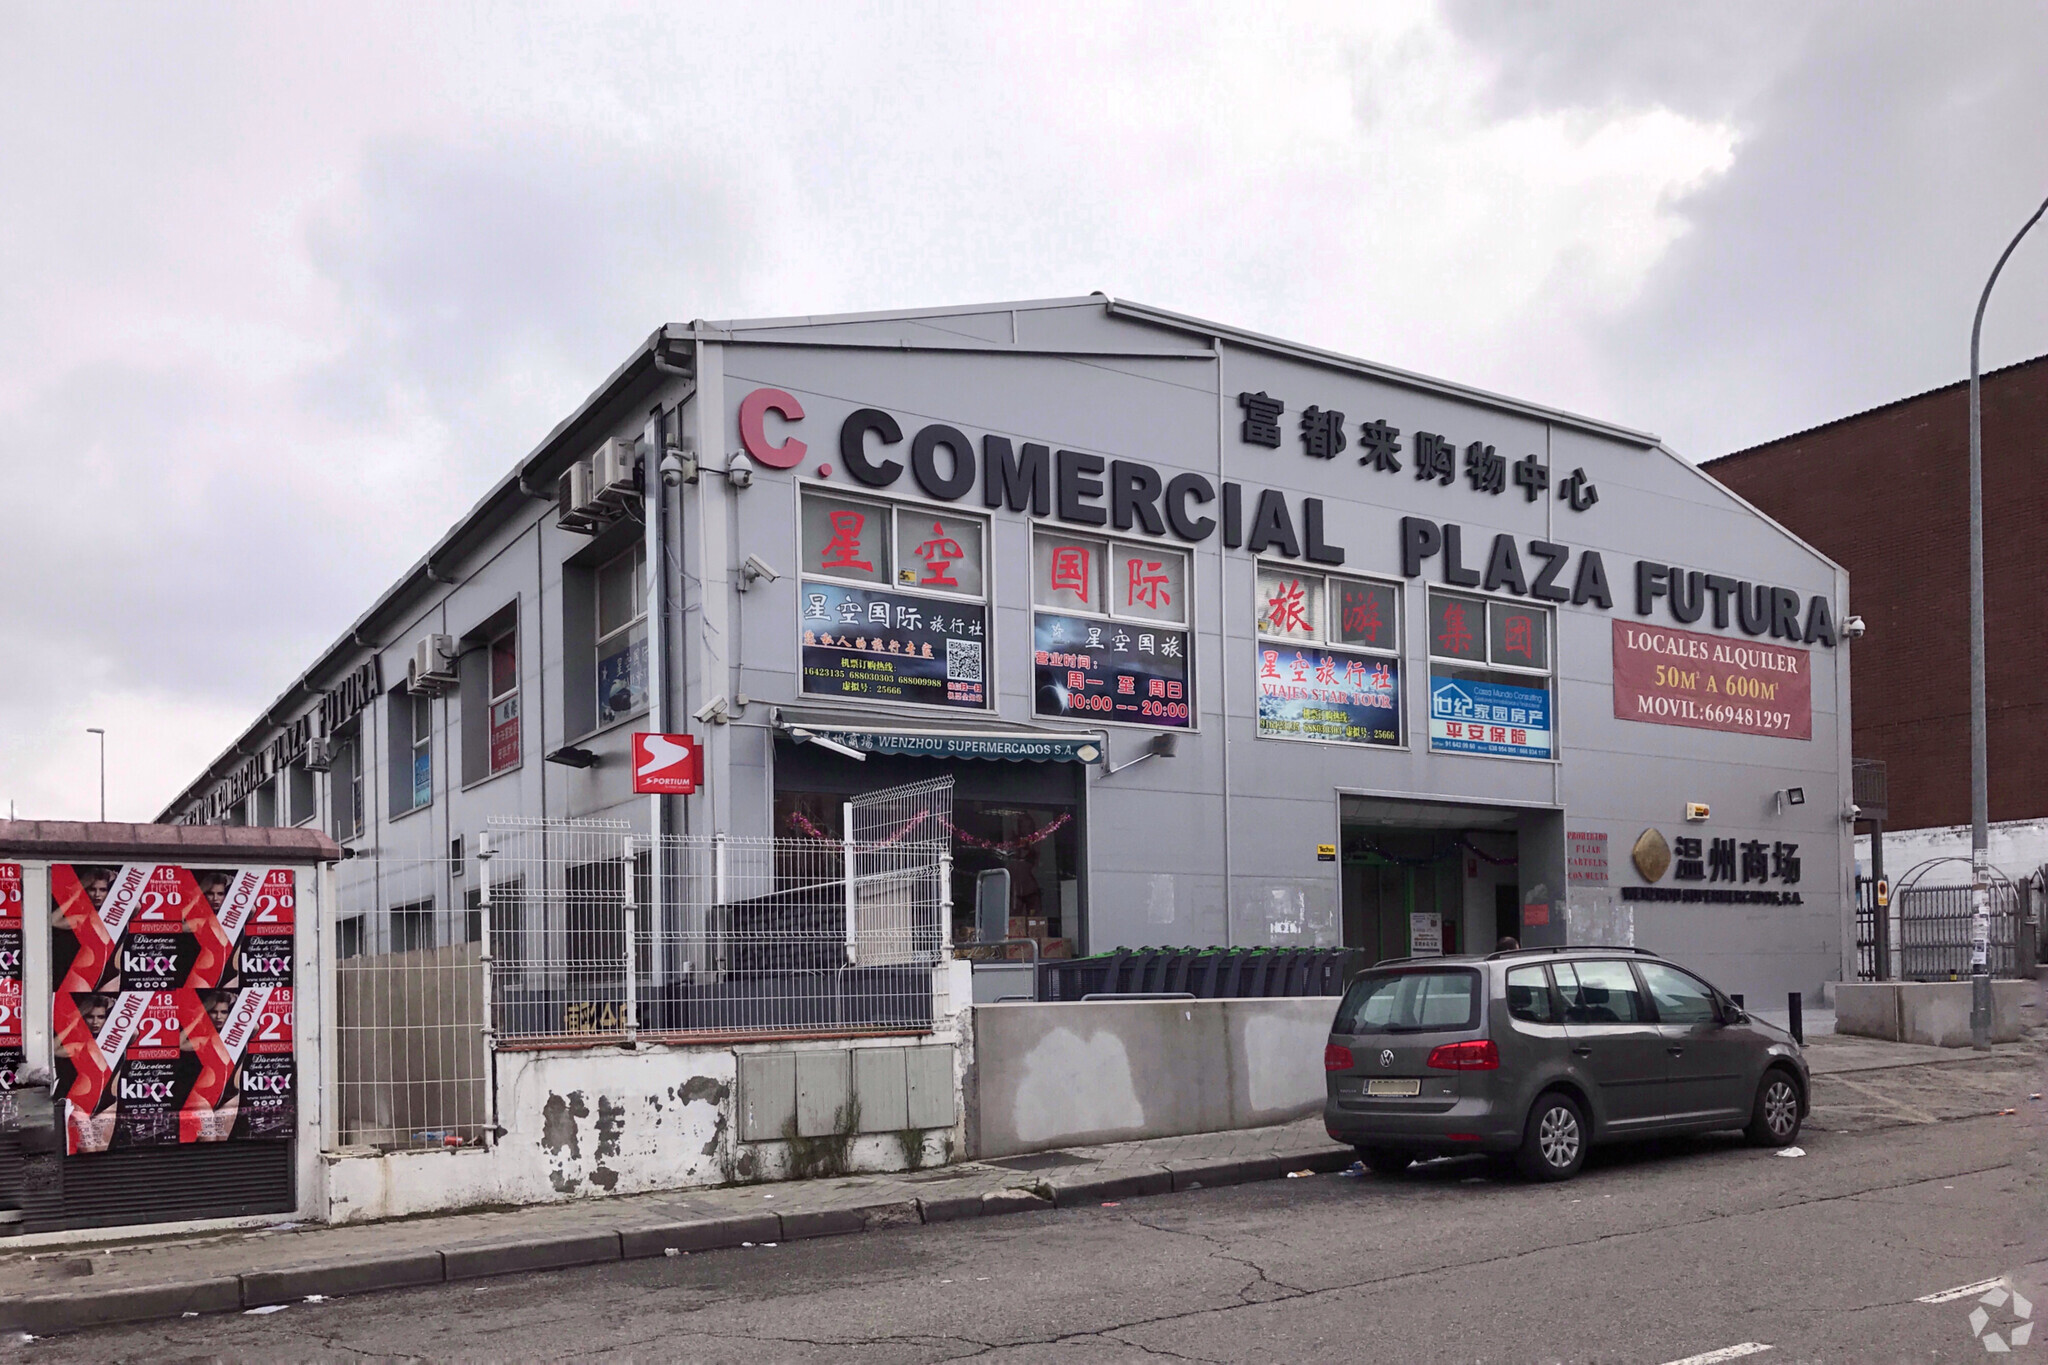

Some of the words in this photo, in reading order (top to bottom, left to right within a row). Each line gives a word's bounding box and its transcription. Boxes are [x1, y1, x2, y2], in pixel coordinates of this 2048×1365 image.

[1240, 391, 1599, 512] 富都来购物中心
[1401, 515, 1613, 609] PLAZA
[1636, 560, 1837, 647] FUTURA
[1627, 630, 1708, 660] LOCALES
[1713, 645, 1798, 674] ALQUILER
[876, 685, 902, 695] 25666
[1706, 674, 1718, 693] A
[318, 654, 386, 737] FUTURA
[1262, 683, 1308, 701] VIAJES
[1311, 689, 1349, 705] STAR
[1352, 692, 1393, 709] TOUR
[1067, 693, 1112, 712] 10:00
[1141, 700, 1188, 719] 20:00
[879, 736, 942, 750] WENZHOU
[948, 740, 1051, 755] SUPERMERCADOS
[1054, 745, 1075, 755] S.A.
[641, 776, 690, 786] SPORTIUM
[1675, 836, 1801, 884] 温州商场
[157, 868, 174, 880] 18
[270, 872, 286, 883] 18
[151, 884, 178, 893] FIESTA
[264, 888, 290, 896] FIESTA
[104, 867, 145, 927] ENAMORATE
[221, 871, 259, 930] ENAMORATE
[134, 934, 175, 944] Discoteca
[250, 936, 288, 945] Discoteca
[155, 994, 173, 1005] 18
[274, 990, 290, 1001] 18
[149, 1010, 176, 1018] FIESTA
[224, 990, 264, 1048] ENAMORATE
[102, 993, 144, 1054] ENAMORATE
[131, 1061, 171, 1070] Discoteca
[252, 1054, 290, 1063] Discoteca
